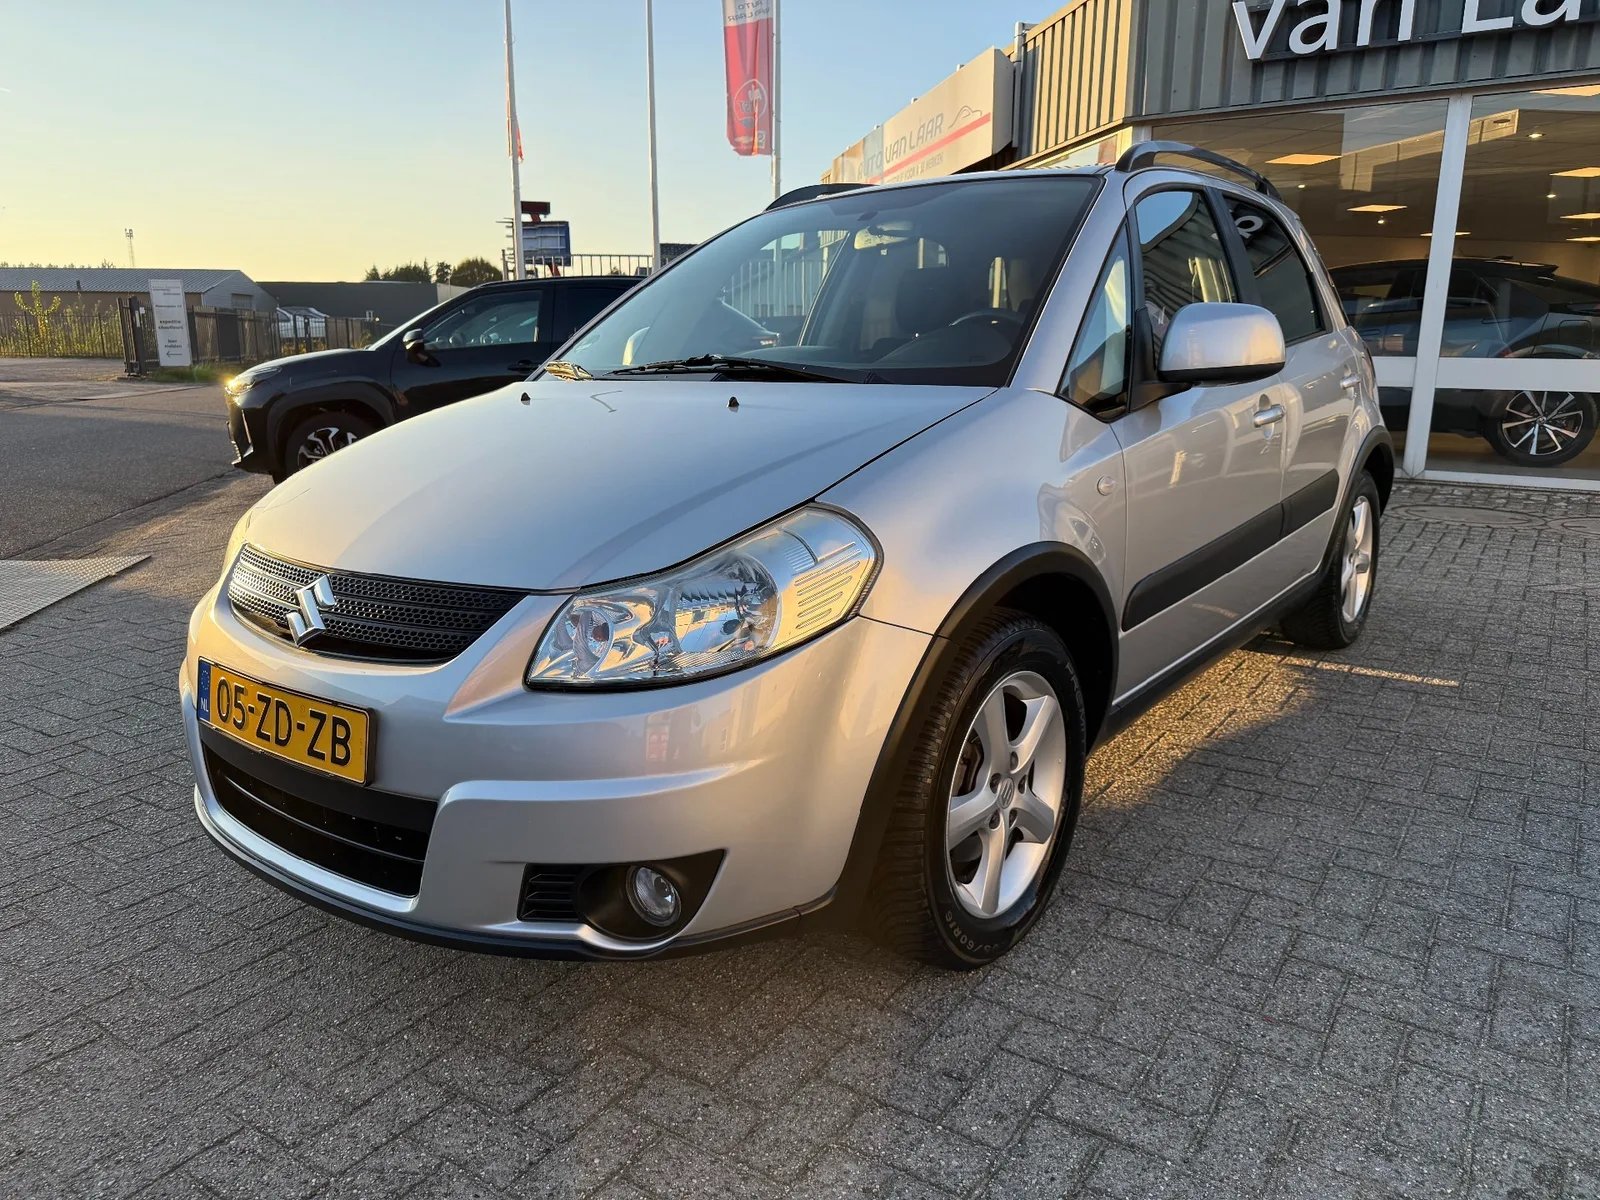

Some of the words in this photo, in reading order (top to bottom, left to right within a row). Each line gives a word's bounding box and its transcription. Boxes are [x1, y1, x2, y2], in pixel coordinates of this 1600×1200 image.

[1232, 0, 1412, 60] van
[885, 136, 907, 164] VAN
[909, 112, 944, 150] LAAR
[200, 697, 209, 713] NL
[216, 676, 352, 767] 05-ZD-ZB
